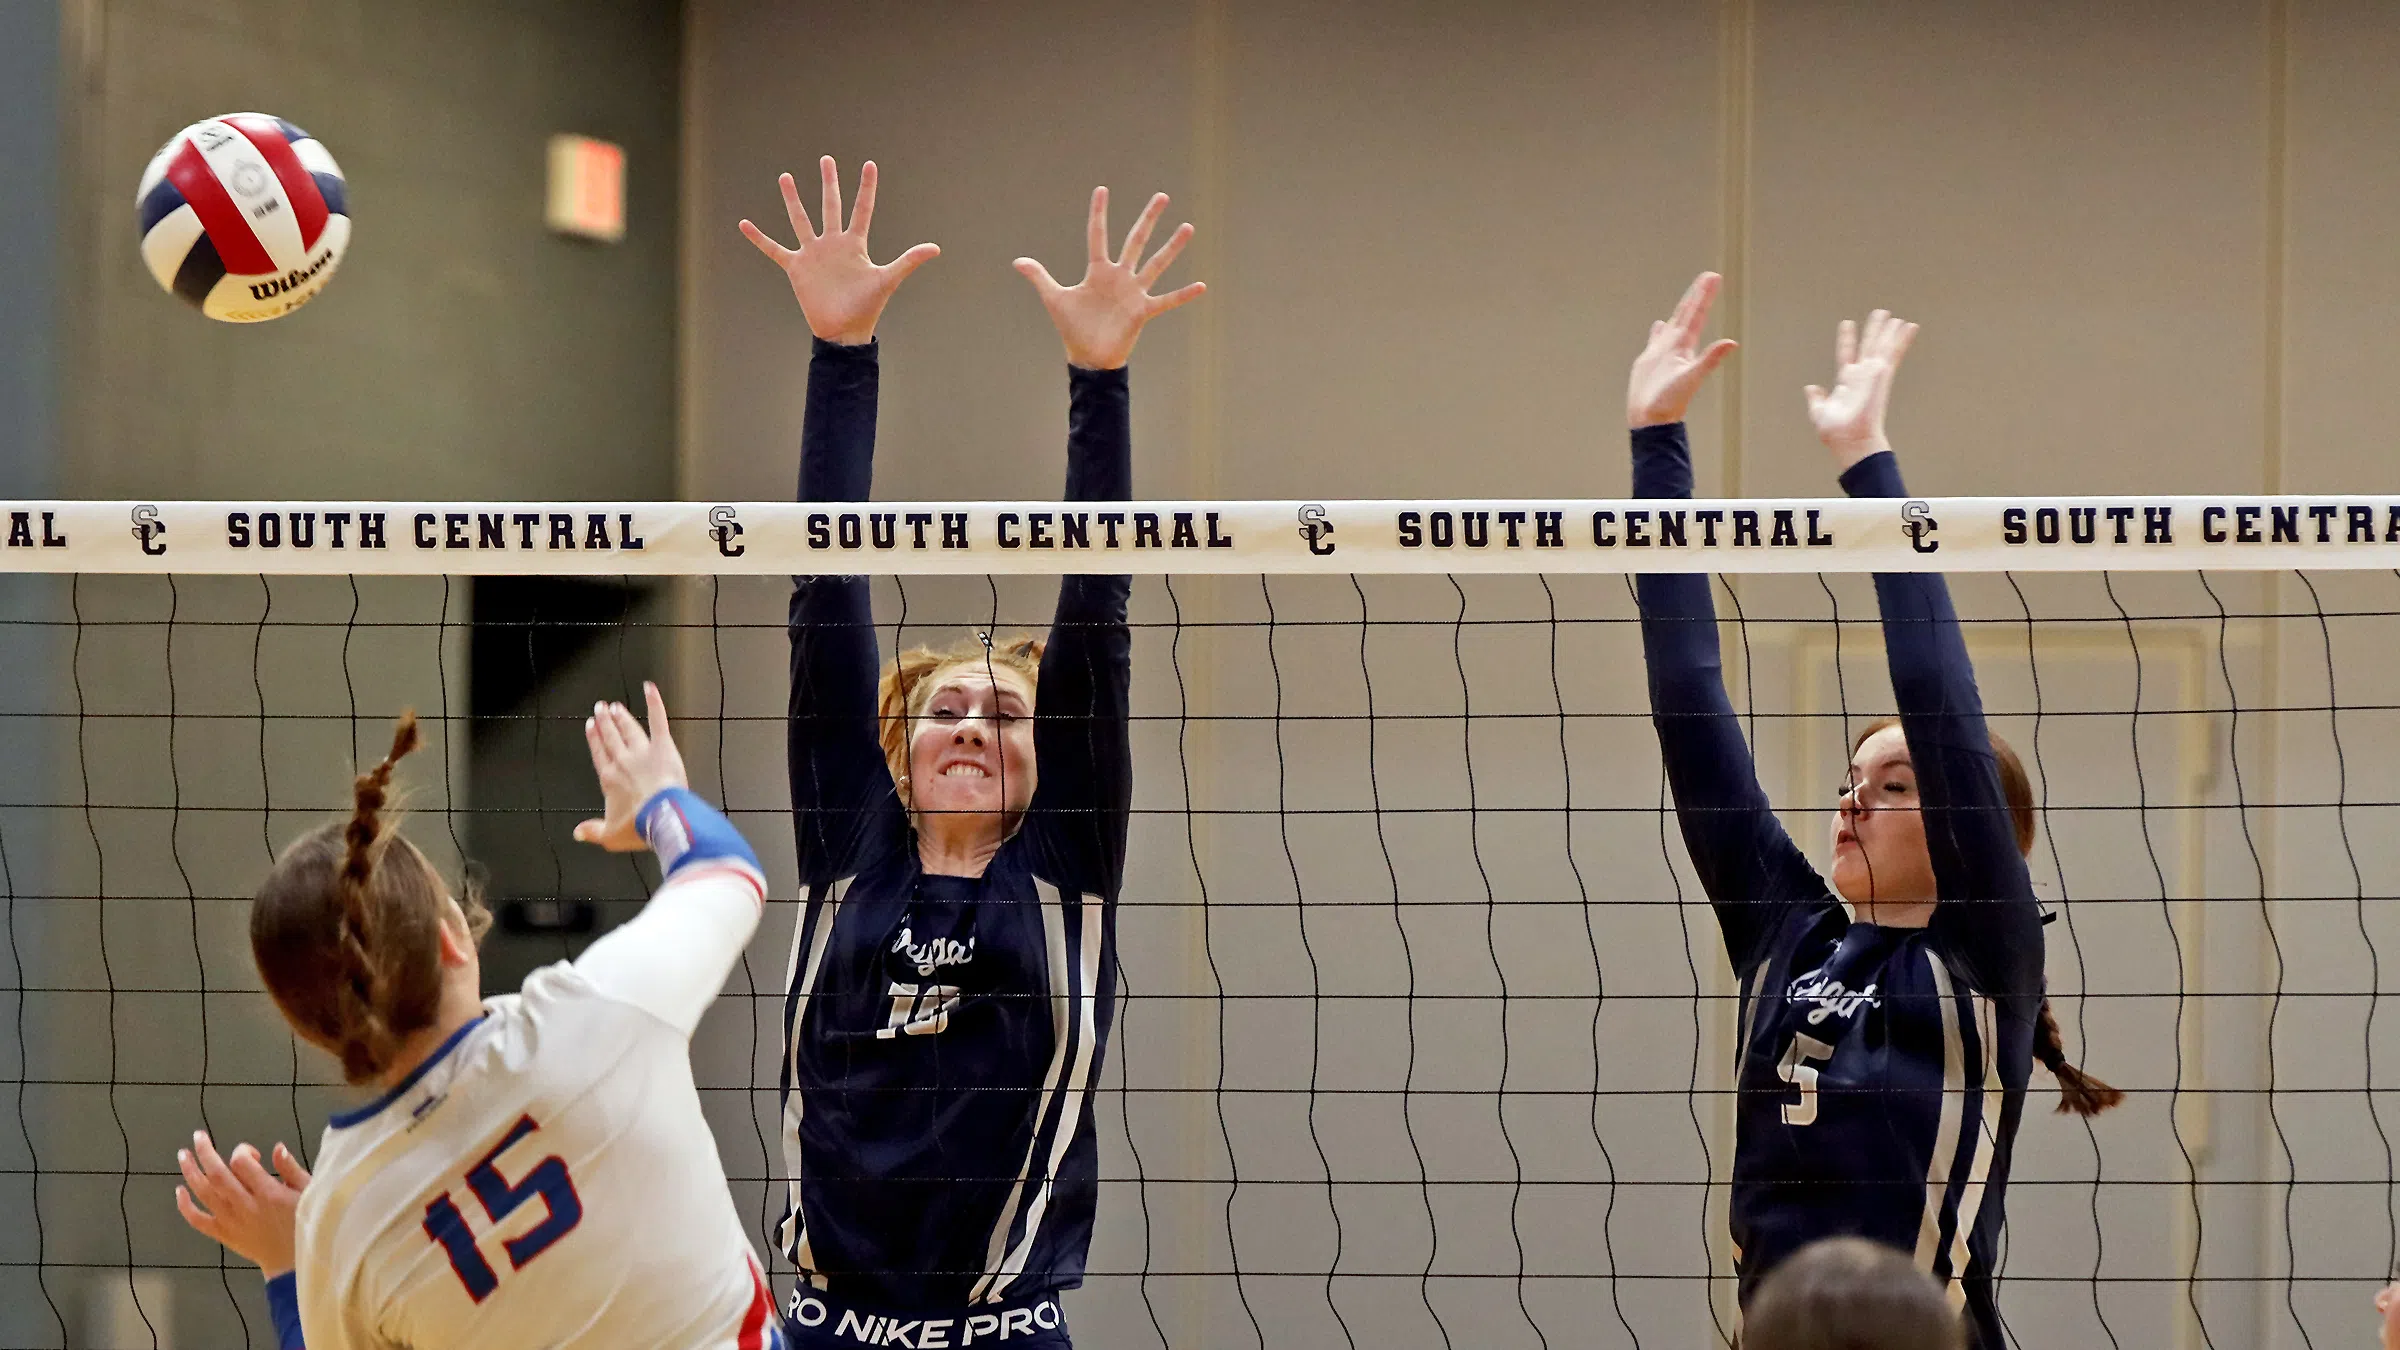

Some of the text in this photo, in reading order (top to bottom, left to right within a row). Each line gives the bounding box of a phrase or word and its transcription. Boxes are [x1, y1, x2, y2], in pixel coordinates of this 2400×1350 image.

[8, 512, 66, 547] AL
[228, 513, 386, 548] SOUTH
[415, 514, 643, 549] CENTRAL
[808, 513, 968, 548] SOUTH
[998, 513, 1232, 548] CENTRAL
[1399, 512, 1563, 547] SOUTH
[1593, 510, 1832, 546] CENTRAL
[2004, 507, 2172, 544] SOUTH
[1776, 1031, 1835, 1126] 5
[422, 1113, 583, 1305] 15
[834, 1309, 954, 1350] NIKE
[961, 1300, 1060, 1347] PRO
